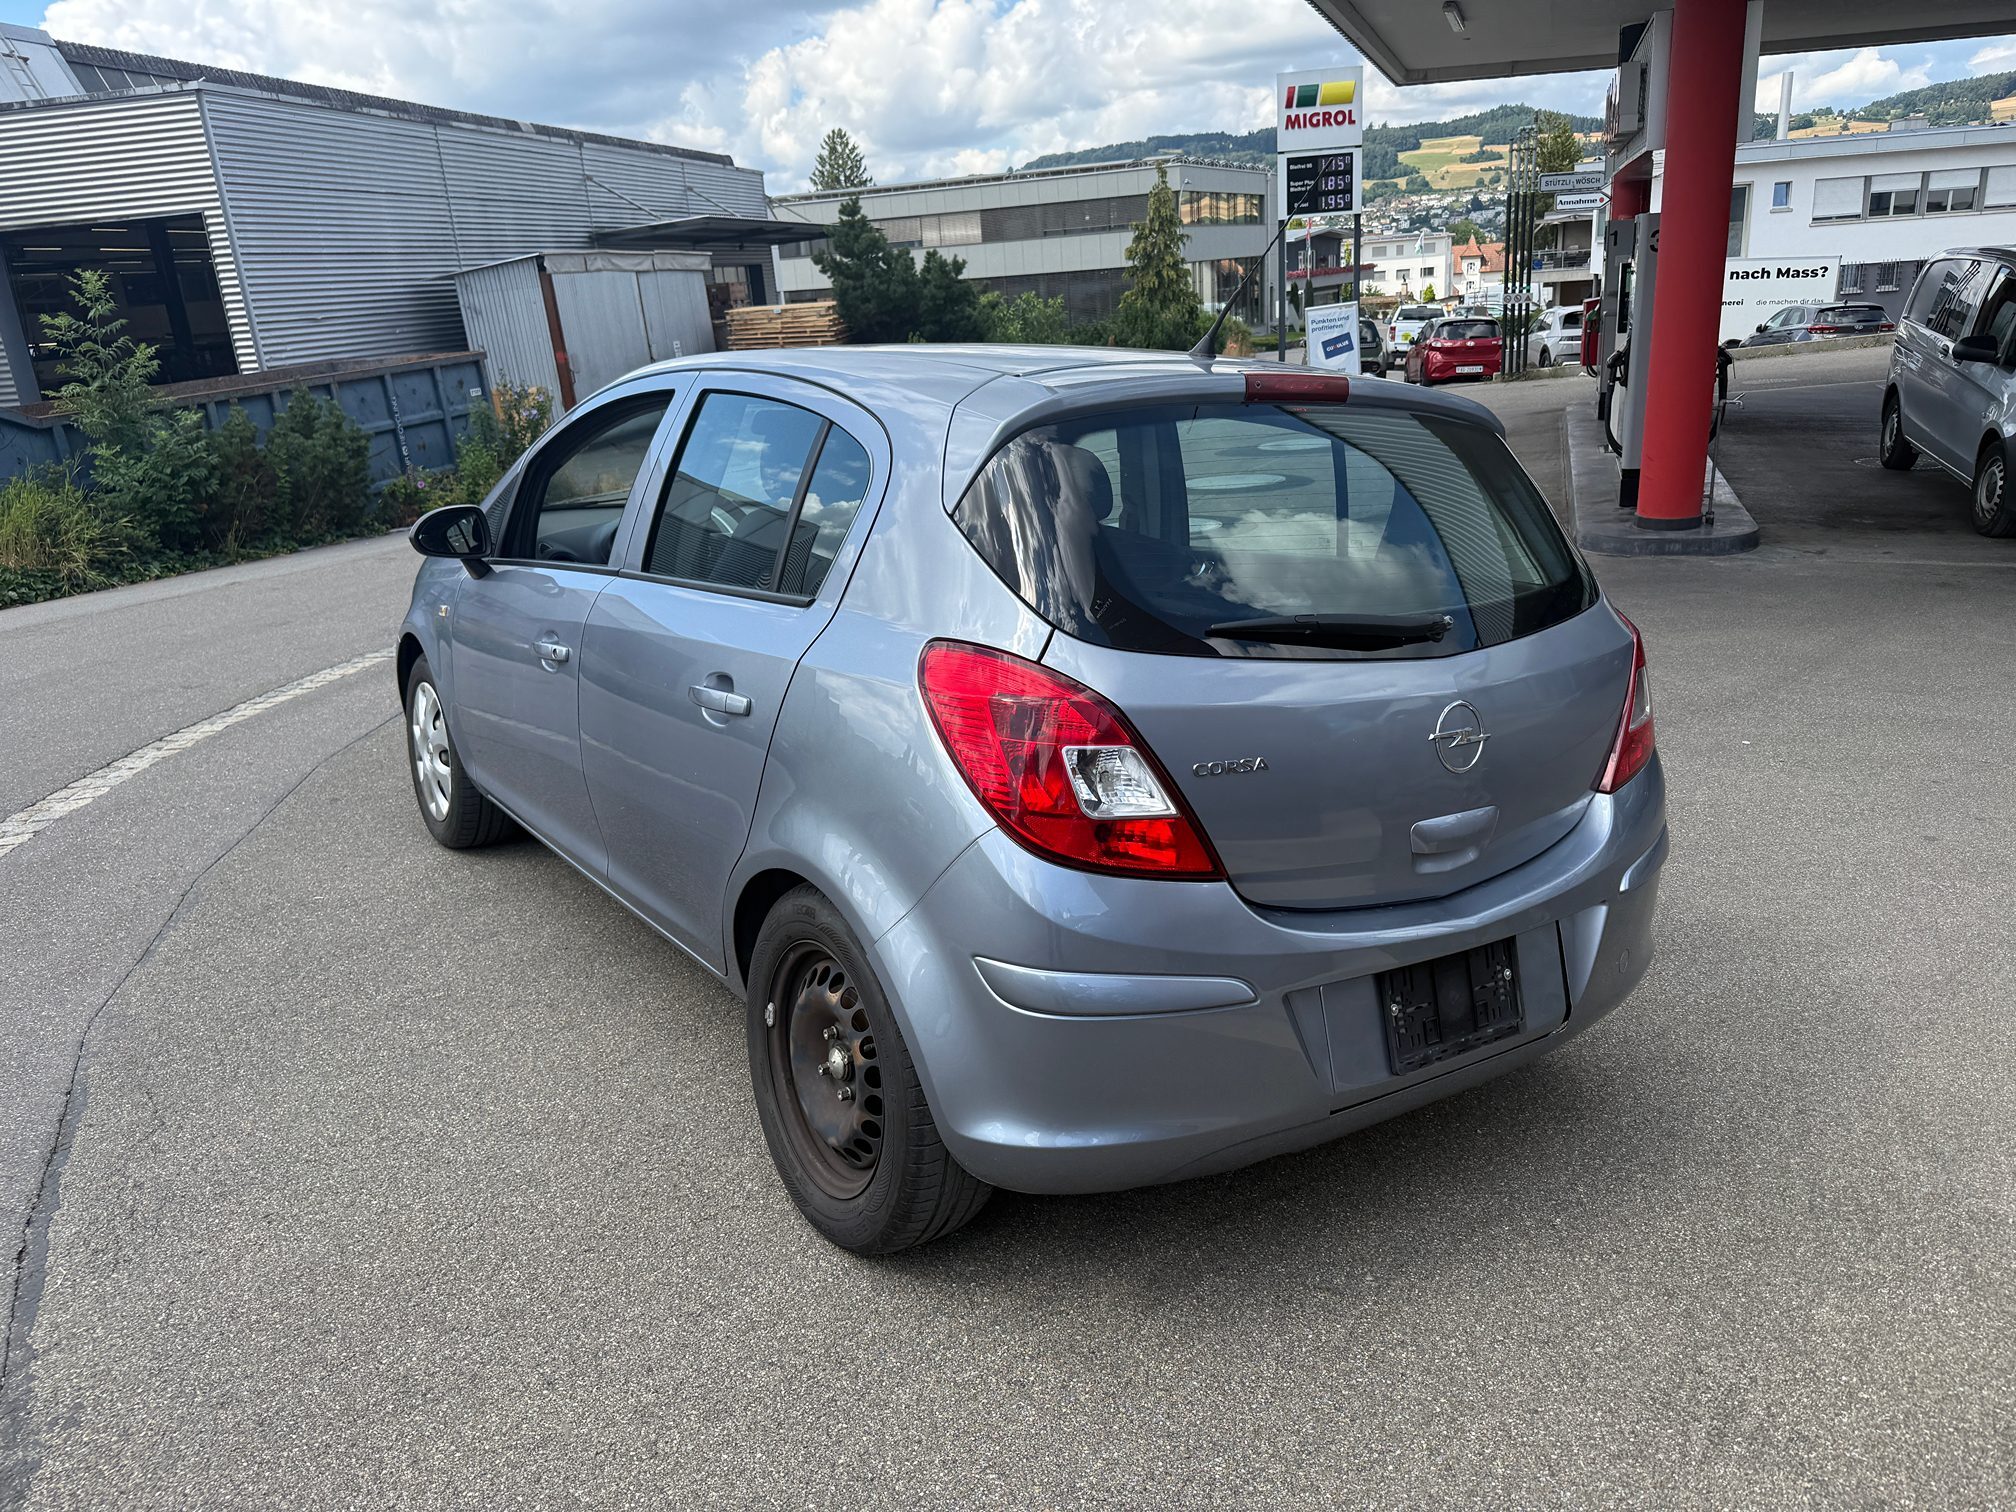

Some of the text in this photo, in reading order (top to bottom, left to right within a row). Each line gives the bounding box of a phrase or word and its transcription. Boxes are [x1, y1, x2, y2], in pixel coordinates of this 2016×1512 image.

[1285, 109, 1356, 130] MIGROL
[1558, 198, 1597, 206] Annahme
[1610, 230, 1618, 246] 1
[1729, 266, 1829, 280] nach Mass?
[1311, 323, 1343, 333] profitieren
[1192, 756, 1269, 777] CORSA
